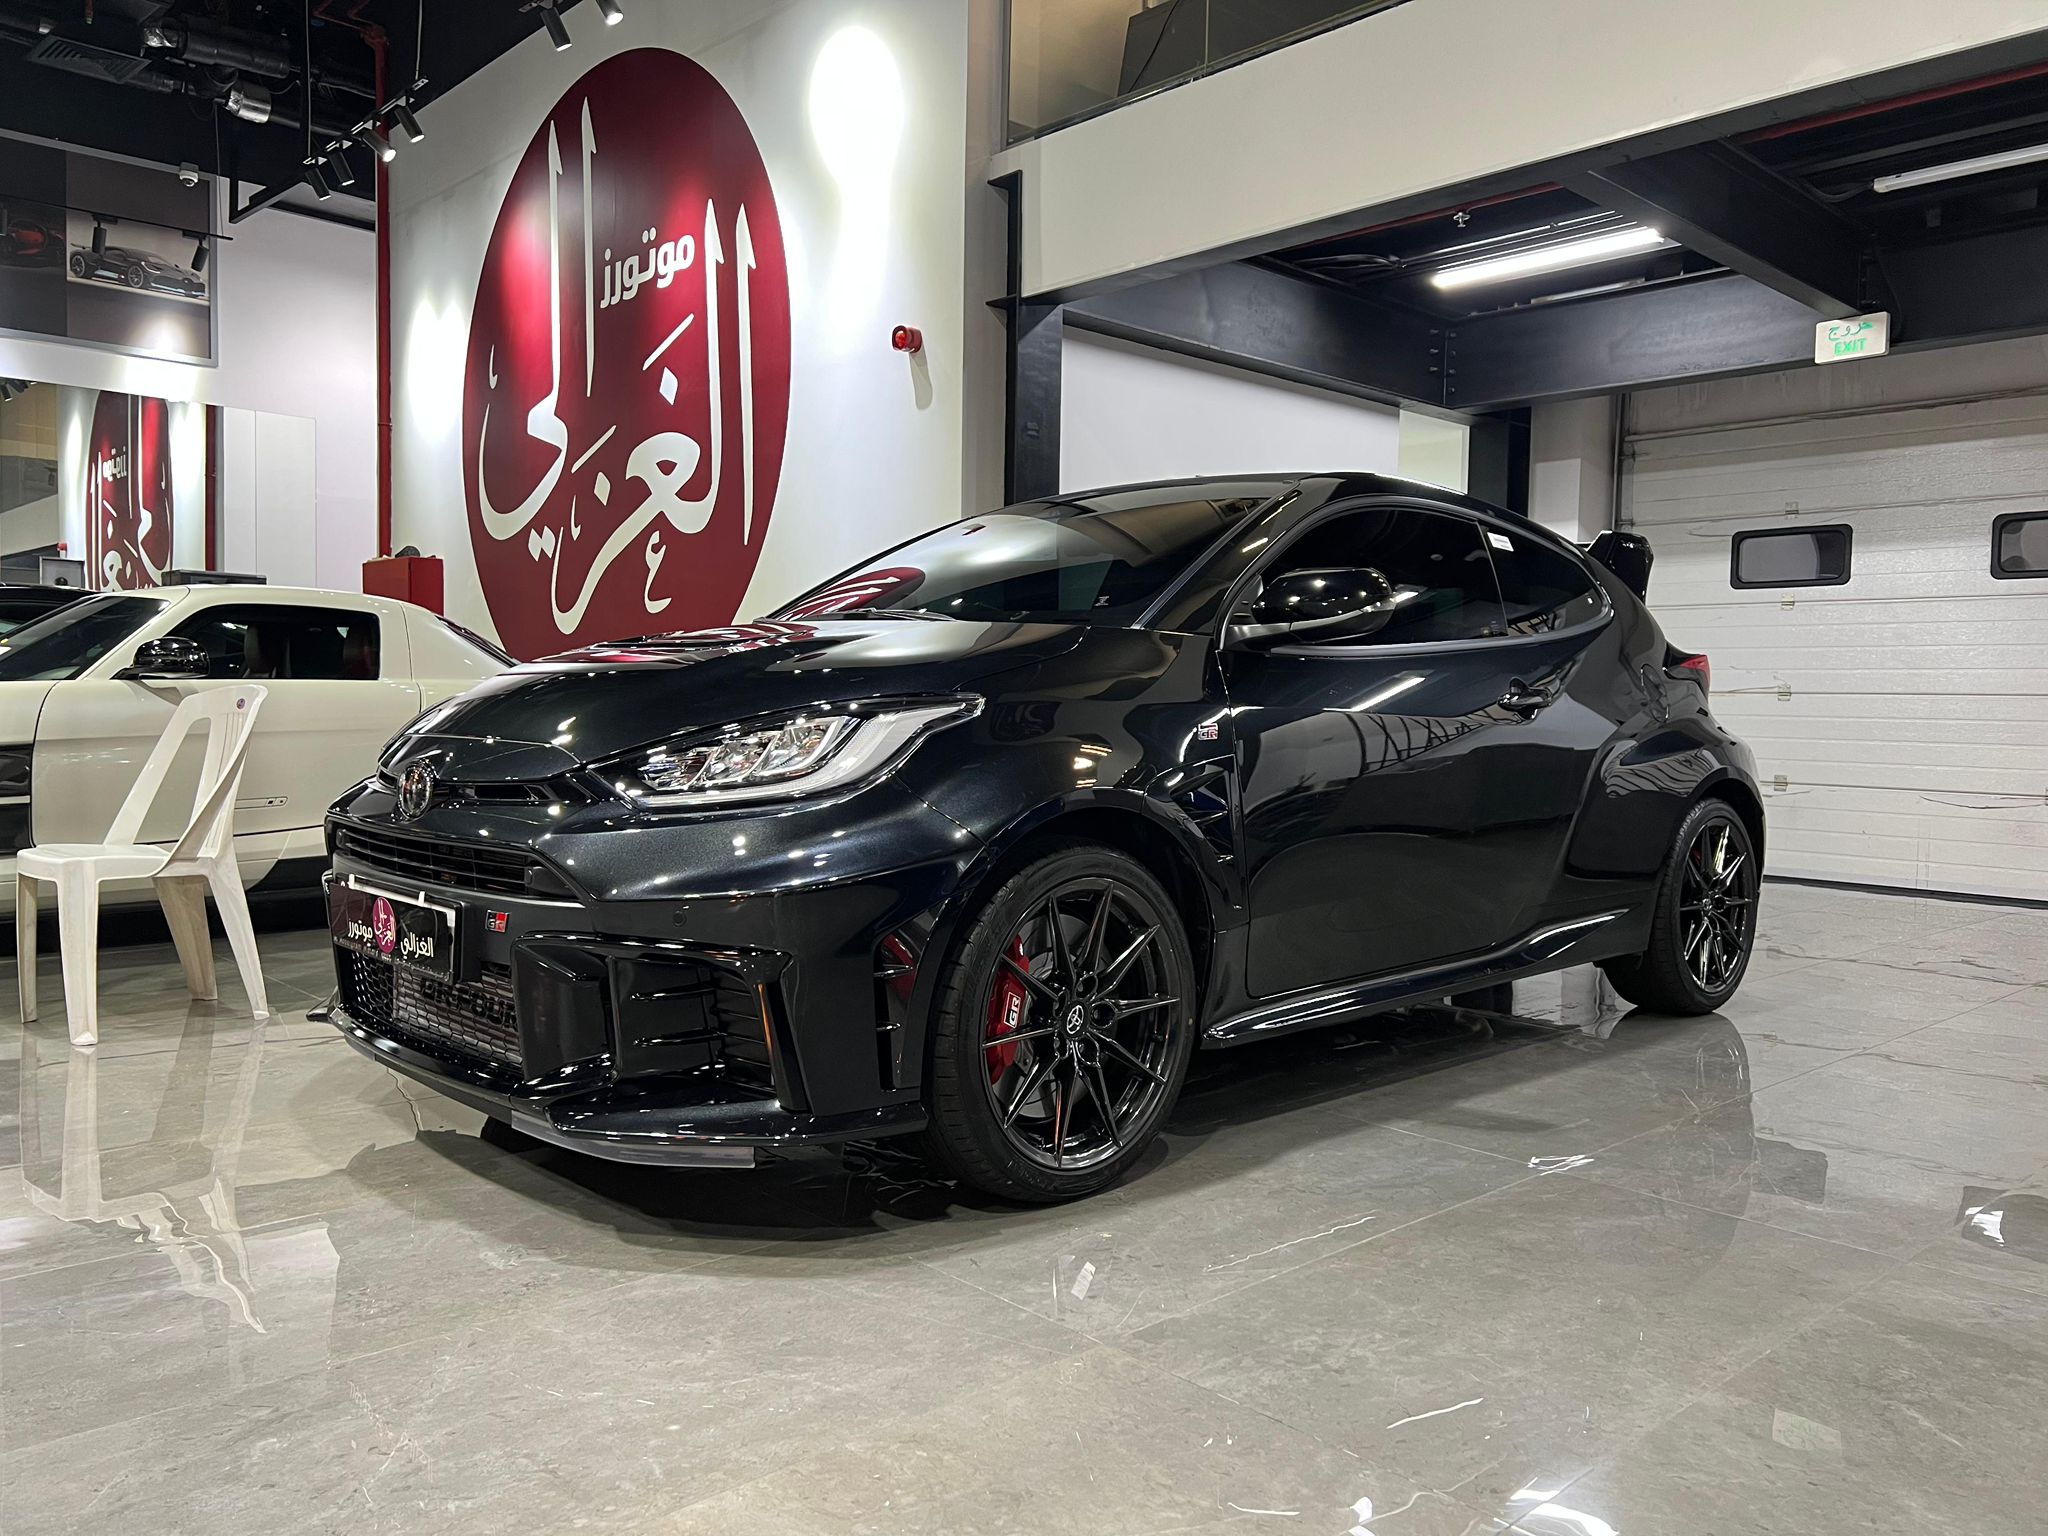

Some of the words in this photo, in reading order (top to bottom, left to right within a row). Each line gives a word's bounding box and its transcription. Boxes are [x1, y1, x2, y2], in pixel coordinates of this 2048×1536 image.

[600, 227, 695, 309] موتورز
[1834, 338, 1867, 355] EXIT
[1200, 730, 1217, 739] GR
[488, 919, 506, 931] GR
[400, 932, 434, 960] الغزالي
[1009, 996, 1020, 1027] GR
